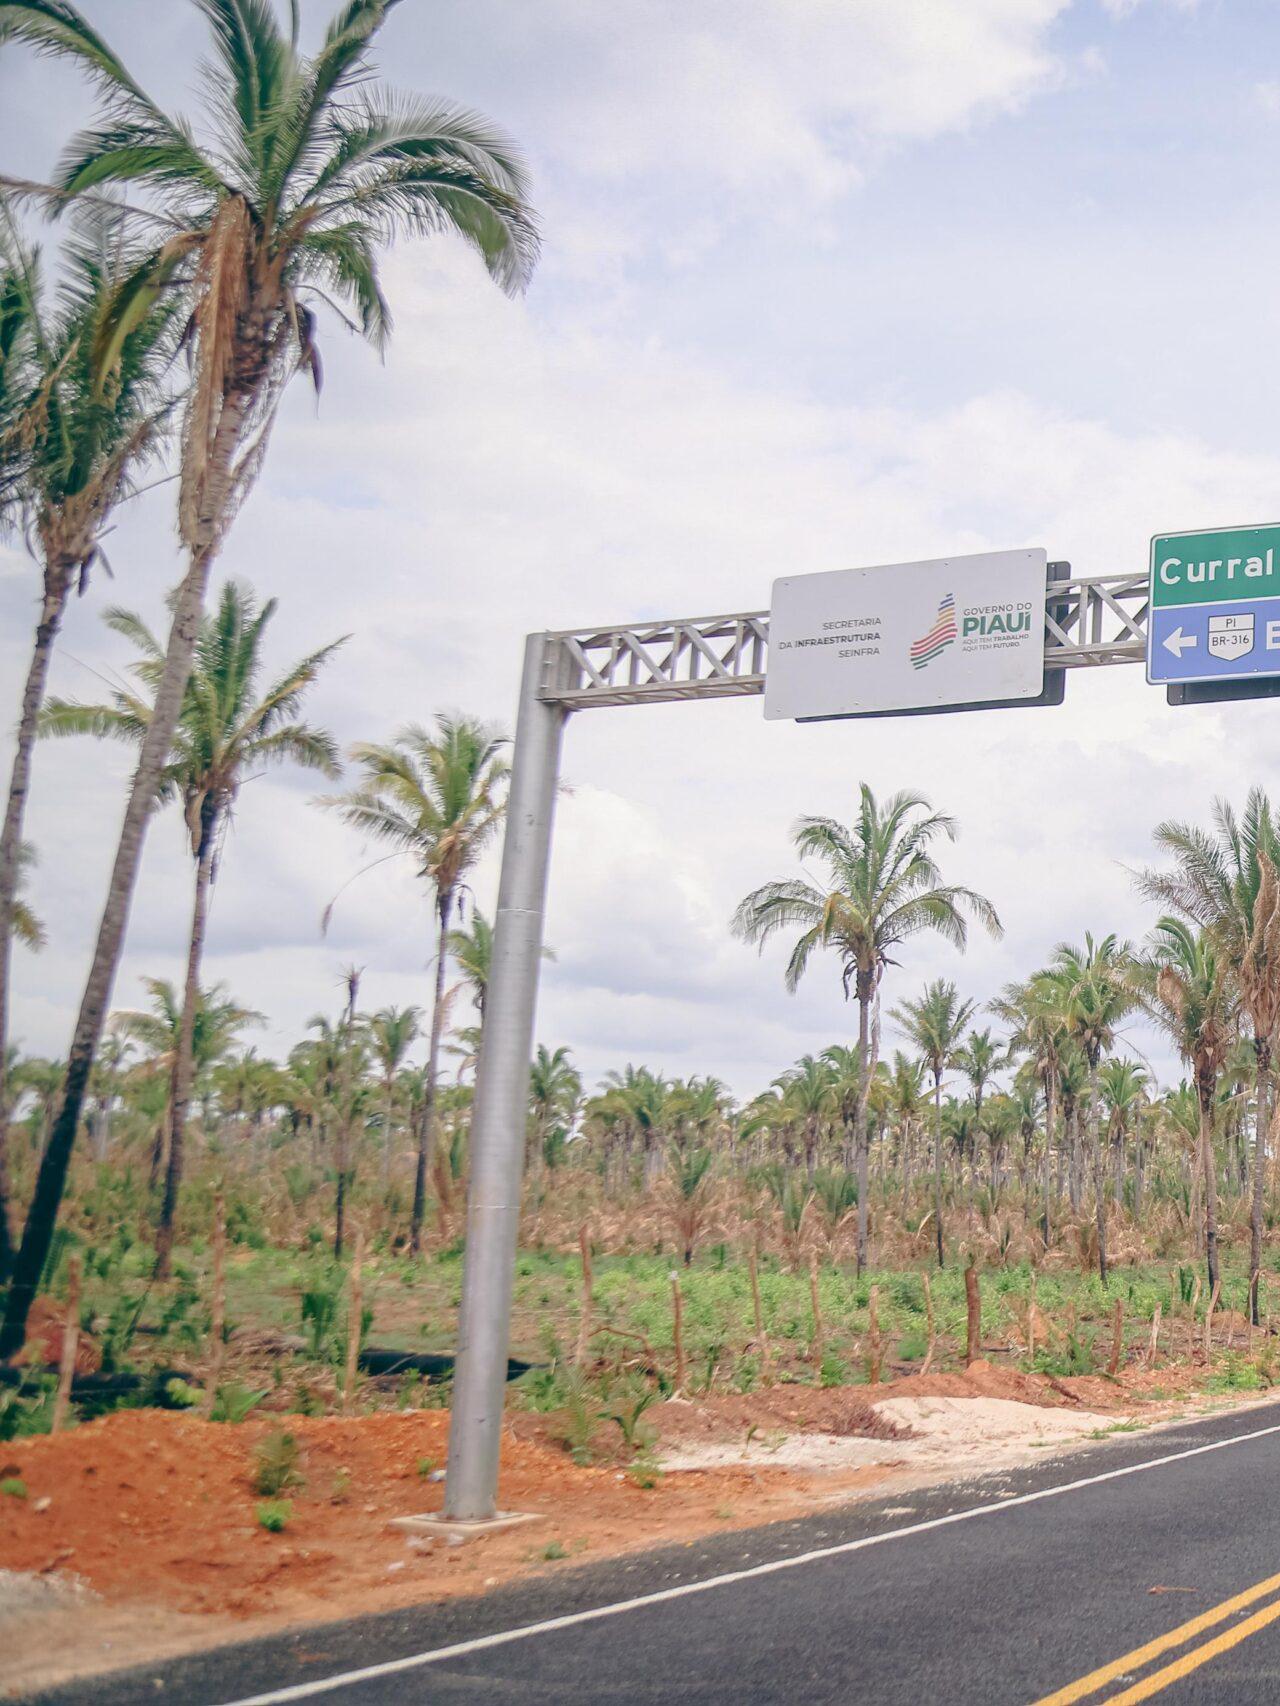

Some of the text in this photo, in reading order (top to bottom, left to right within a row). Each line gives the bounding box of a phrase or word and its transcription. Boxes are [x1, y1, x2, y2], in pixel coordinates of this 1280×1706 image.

[963, 602, 1033, 616] GOVERNO DO
[822, 617, 882, 630] SECRETARIA
[962, 611, 1032, 637] PIAUÍ
[1225, 618, 1236, 628] PI
[779, 632, 881, 650] DA INFRAESTRUTURA
[1212, 635, 1250, 647] BR-316
[838, 647, 881, 658] SEINFRA
